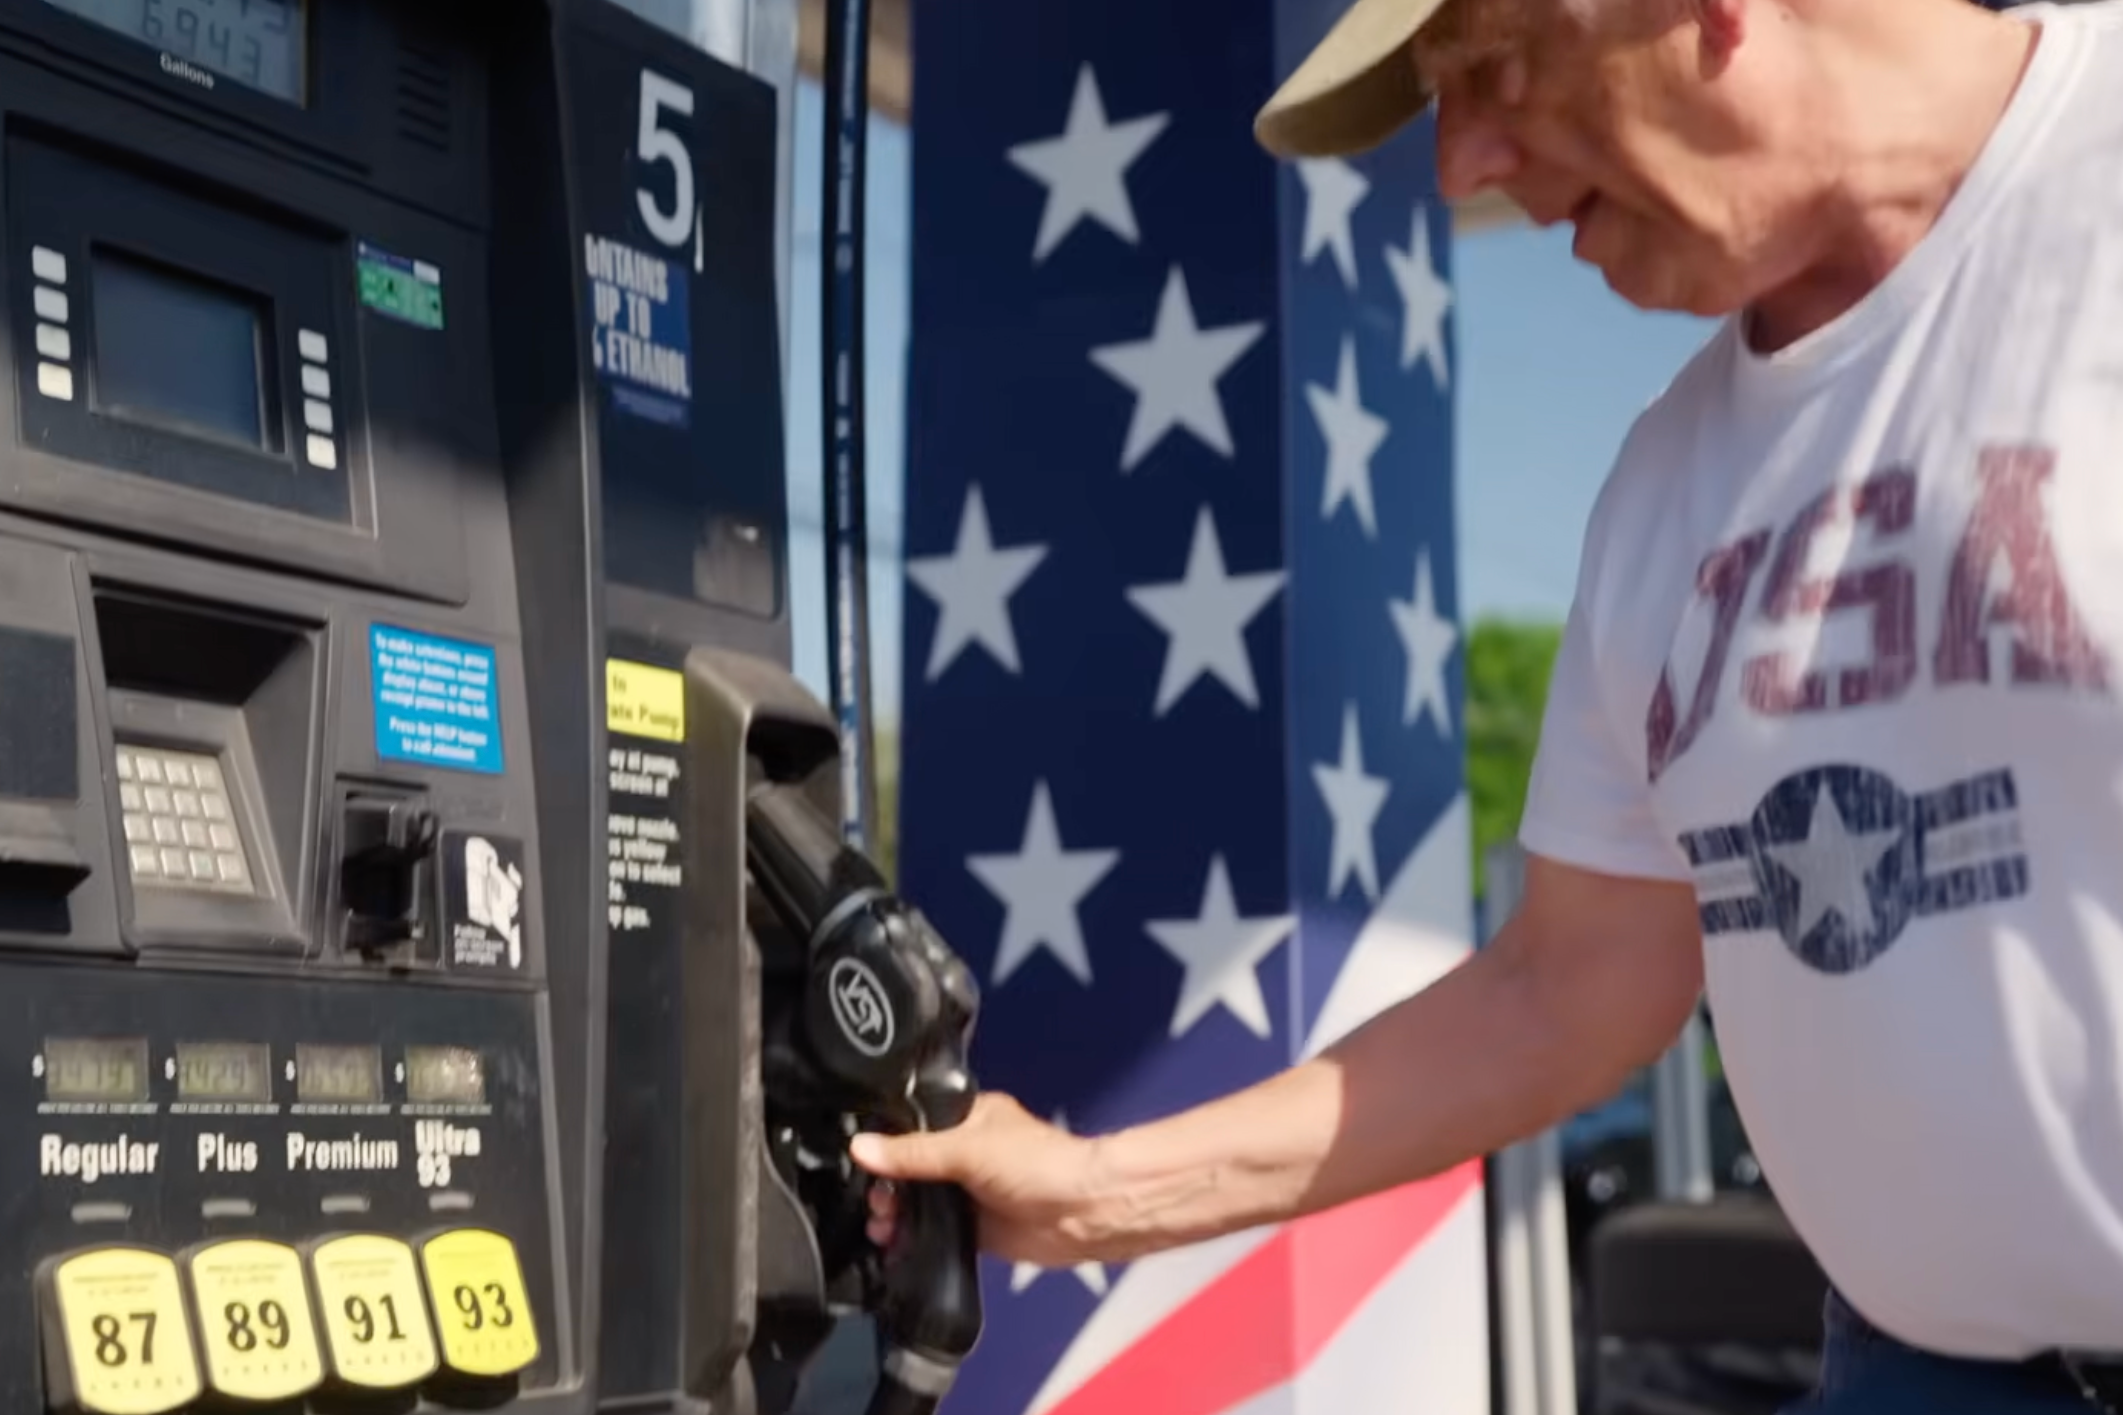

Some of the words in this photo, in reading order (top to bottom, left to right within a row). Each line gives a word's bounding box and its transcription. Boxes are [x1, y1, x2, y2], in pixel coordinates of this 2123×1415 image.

[160, 52, 215, 91] Gallons
[636, 68, 694, 247] 5
[594, 280, 620, 327] UP
[626, 290, 651, 340] TO
[607, 328, 692, 399] ETHANOL
[40, 1132, 160, 1183] Regular
[197, 1132, 259, 1173] Plus
[286, 1132, 399, 1172] Premium
[414, 1119, 482, 1157] Ultra
[416, 1154, 452, 1188] 93
[224, 1300, 291, 1353] 89
[343, 1292, 407, 1344] 91
[453, 1282, 514, 1332] 93
[91, 1311, 158, 1368] 87
